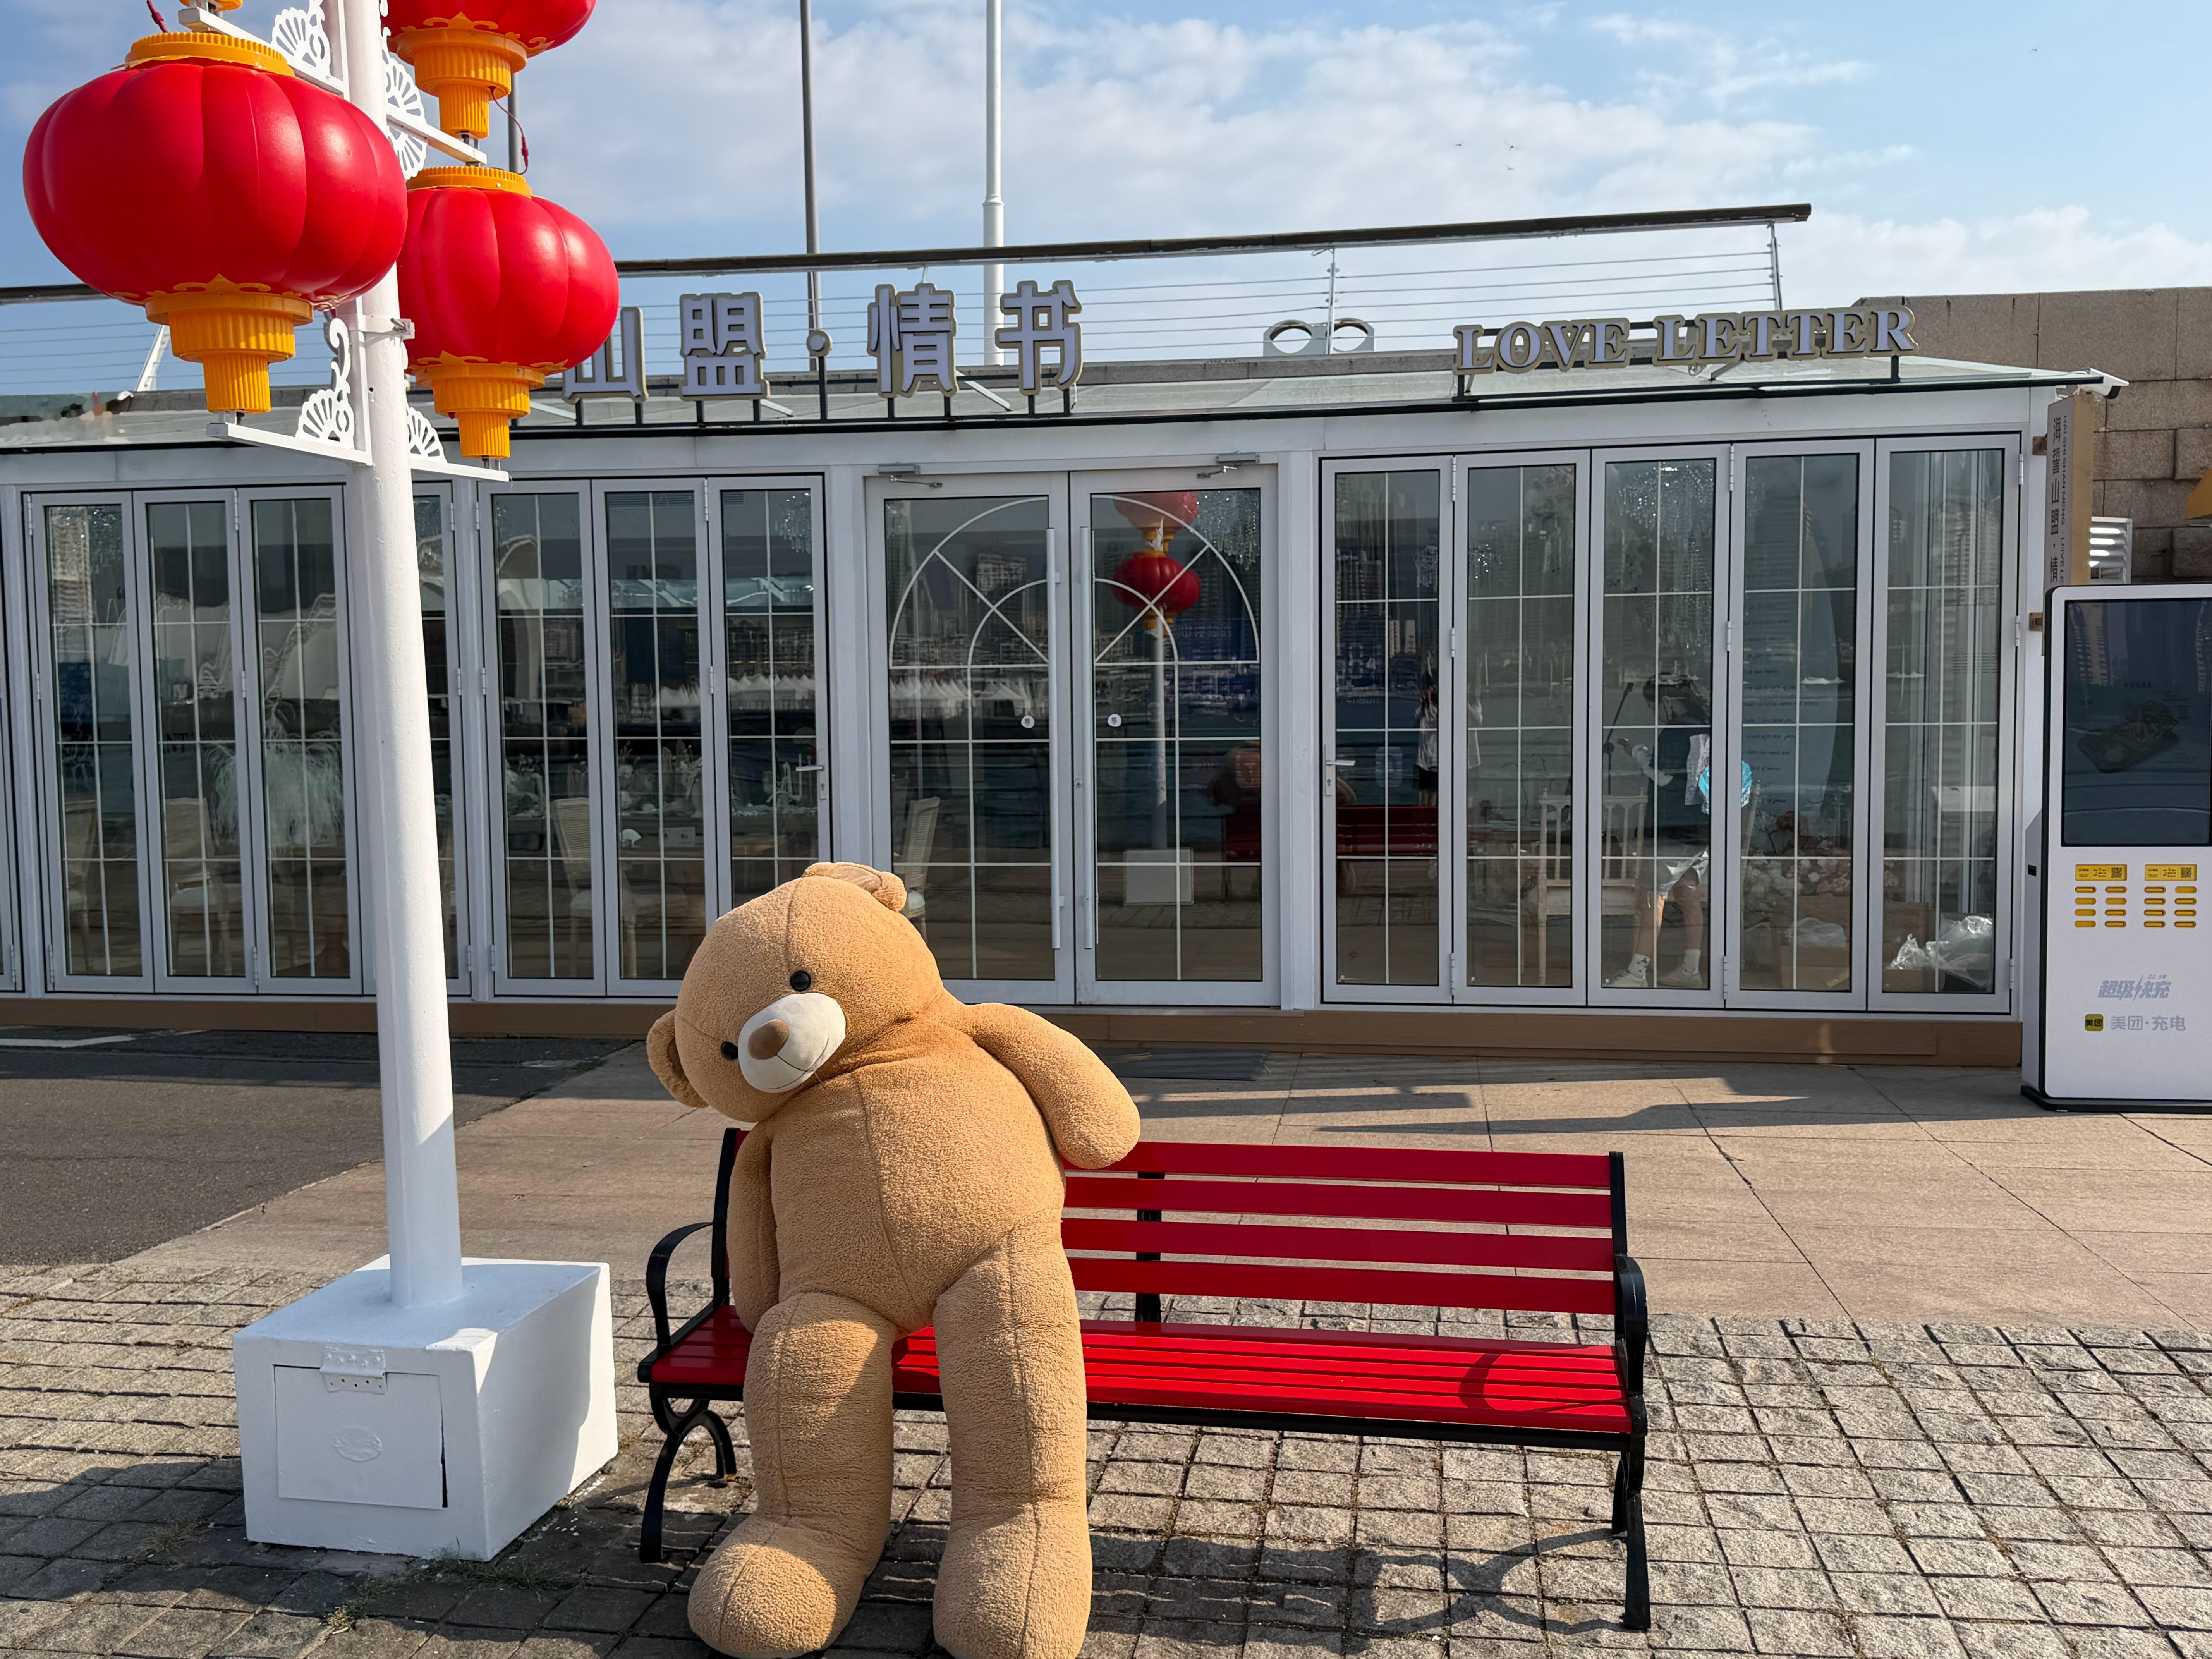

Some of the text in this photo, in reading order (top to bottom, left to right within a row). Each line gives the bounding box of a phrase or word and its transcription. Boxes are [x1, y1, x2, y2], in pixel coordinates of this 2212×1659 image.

[1454, 308, 1918, 373] LOVE LETTER
[2097, 976, 2171, 1001] 超级快充
[2111, 1015, 2186, 1031] 美团·充电
